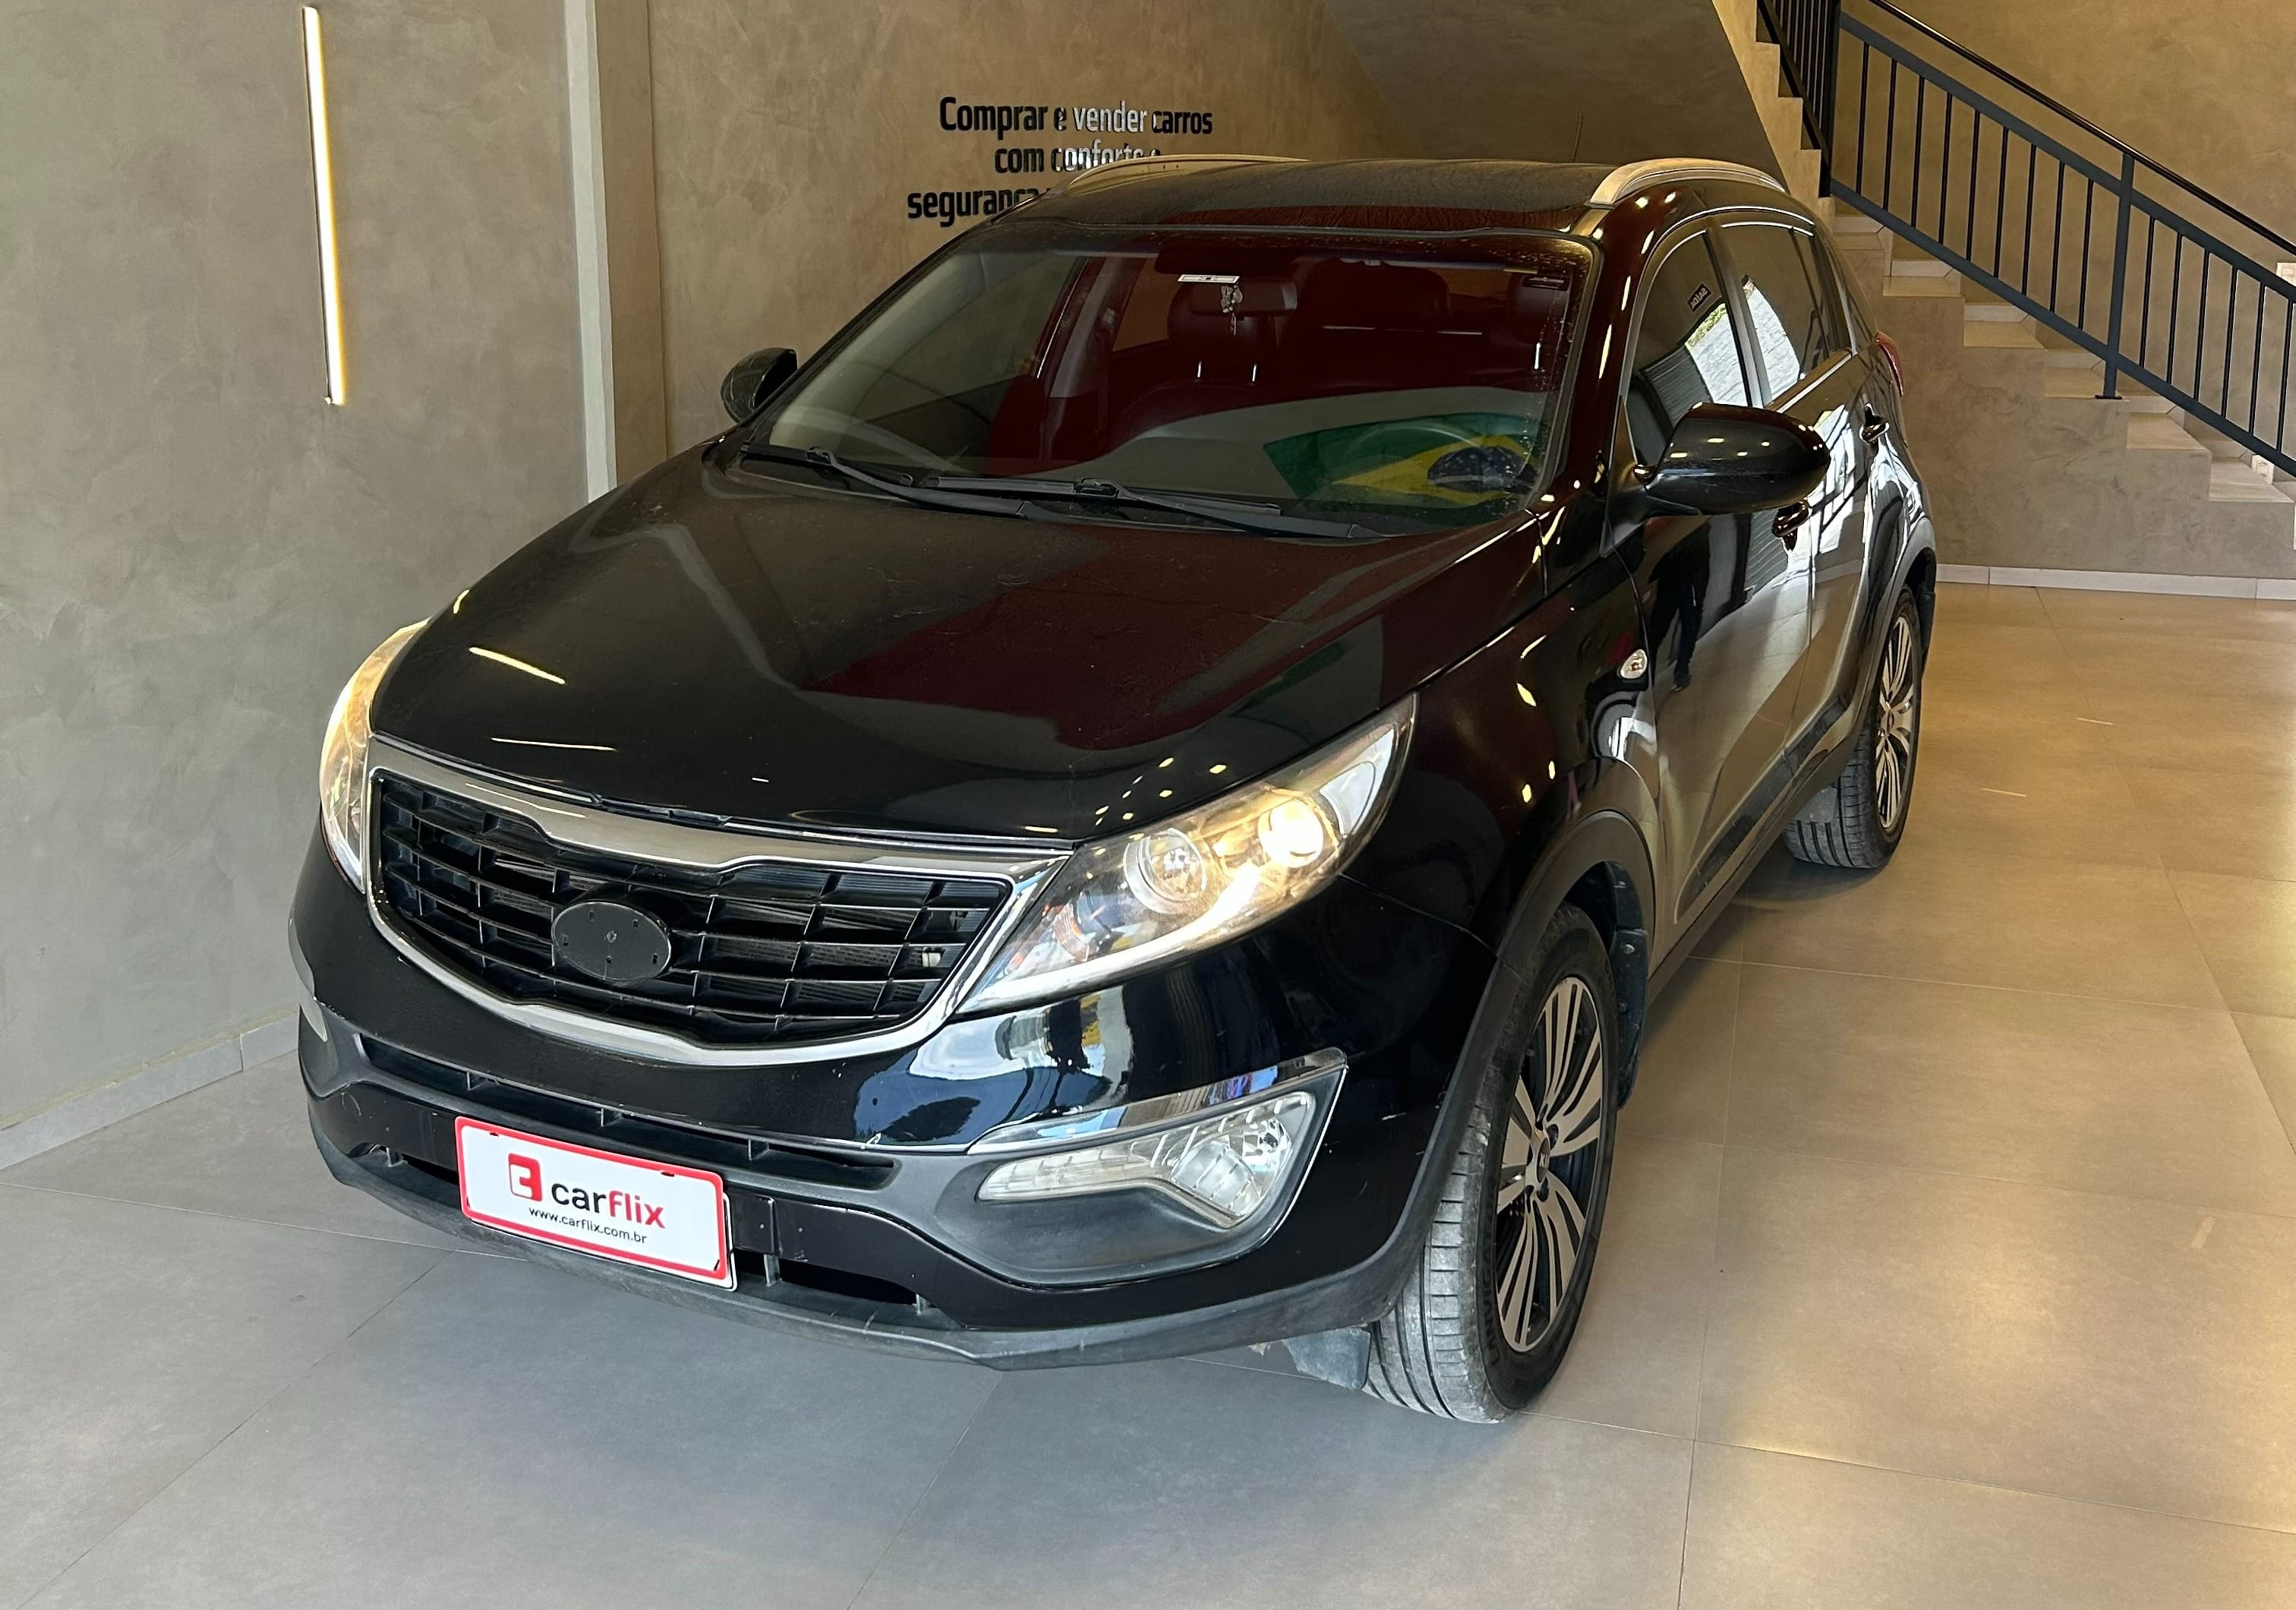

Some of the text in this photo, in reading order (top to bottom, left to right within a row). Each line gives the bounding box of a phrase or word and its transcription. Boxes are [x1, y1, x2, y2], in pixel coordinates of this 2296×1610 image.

[940, 96, 1213, 140] Comprar e vender carros
[995, 148, 1044, 173] com
[528, 1208, 648, 1244] www.carflix.com.br
[551, 1182, 666, 1230] carflix
